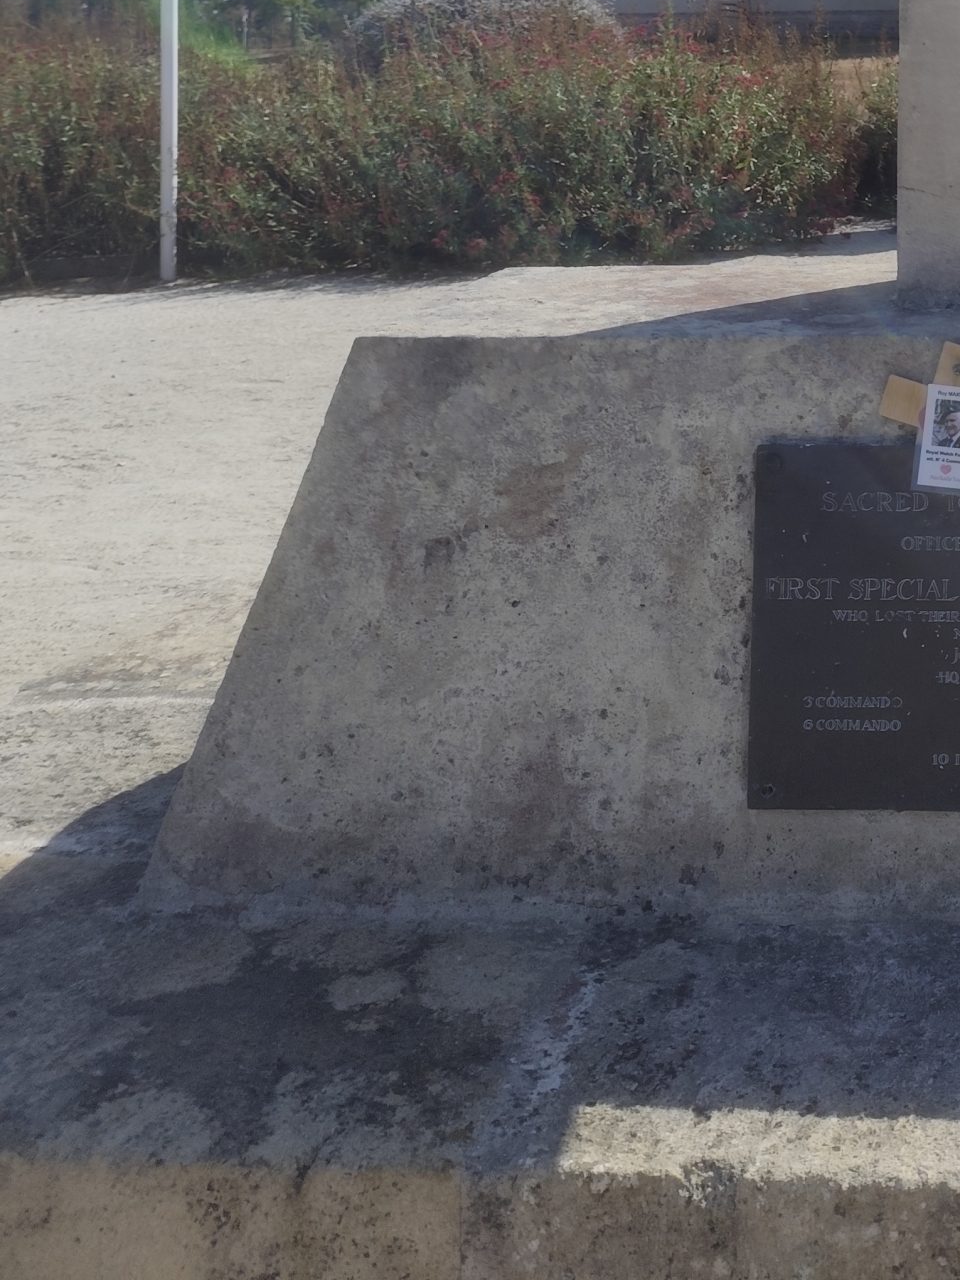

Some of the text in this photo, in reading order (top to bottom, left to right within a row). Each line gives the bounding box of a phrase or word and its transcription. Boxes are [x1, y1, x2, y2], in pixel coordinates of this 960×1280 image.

[820, 491, 929, 512] SACRED
[765, 577, 840, 600] FIRST
[848, 578, 959, 601] SPECIAL
[832, 610, 868, 621] WHO
[920, 611, 960, 622] THEIR
[802, 696, 903, 709] 3 COMMANDO
[802, 720, 902, 732] 6 COMMANDO
[931, 753, 950, 766] 10
